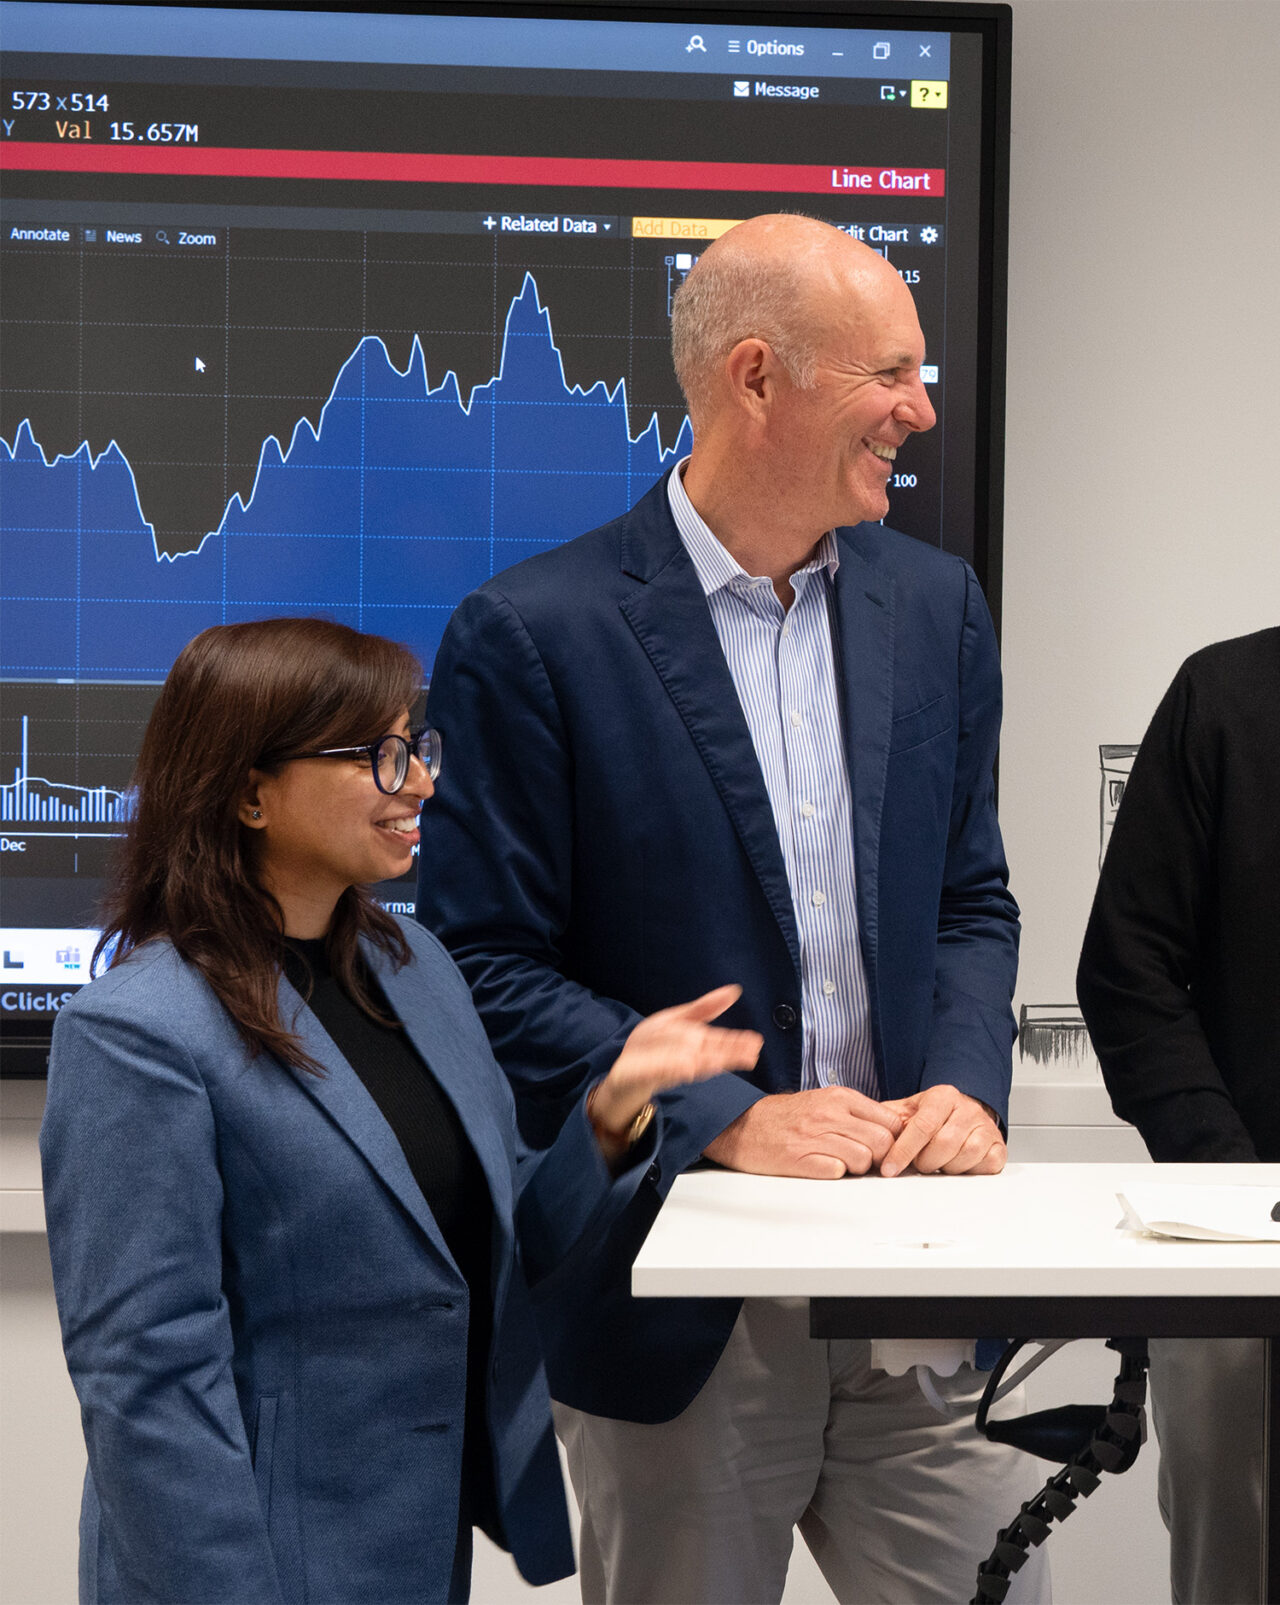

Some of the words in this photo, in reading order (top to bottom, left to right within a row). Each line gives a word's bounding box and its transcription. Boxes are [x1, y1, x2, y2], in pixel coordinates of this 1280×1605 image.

[746, 40, 805, 58] Options
[755, 82, 820, 101] Message
[919, 87, 930, 102] ?
[12, 92, 50, 111] 573
[71, 95, 109, 113] 514
[56, 121, 92, 139] Val
[110, 122, 199, 142] 15.657M
[832, 170, 872, 188] Line
[878, 171, 931, 190] Chart
[501, 216, 559, 233] Related
[562, 218, 598, 234] Data
[634, 220, 664, 236] Add
[670, 221, 708, 237] Data
[869, 226, 909, 241] Chart
[11, 228, 70, 242] Annotate
[106, 230, 142, 243] News
[178, 232, 216, 246] Zoom
[893, 474, 917, 488] 100
[0, 838, 26, 852] Dec
